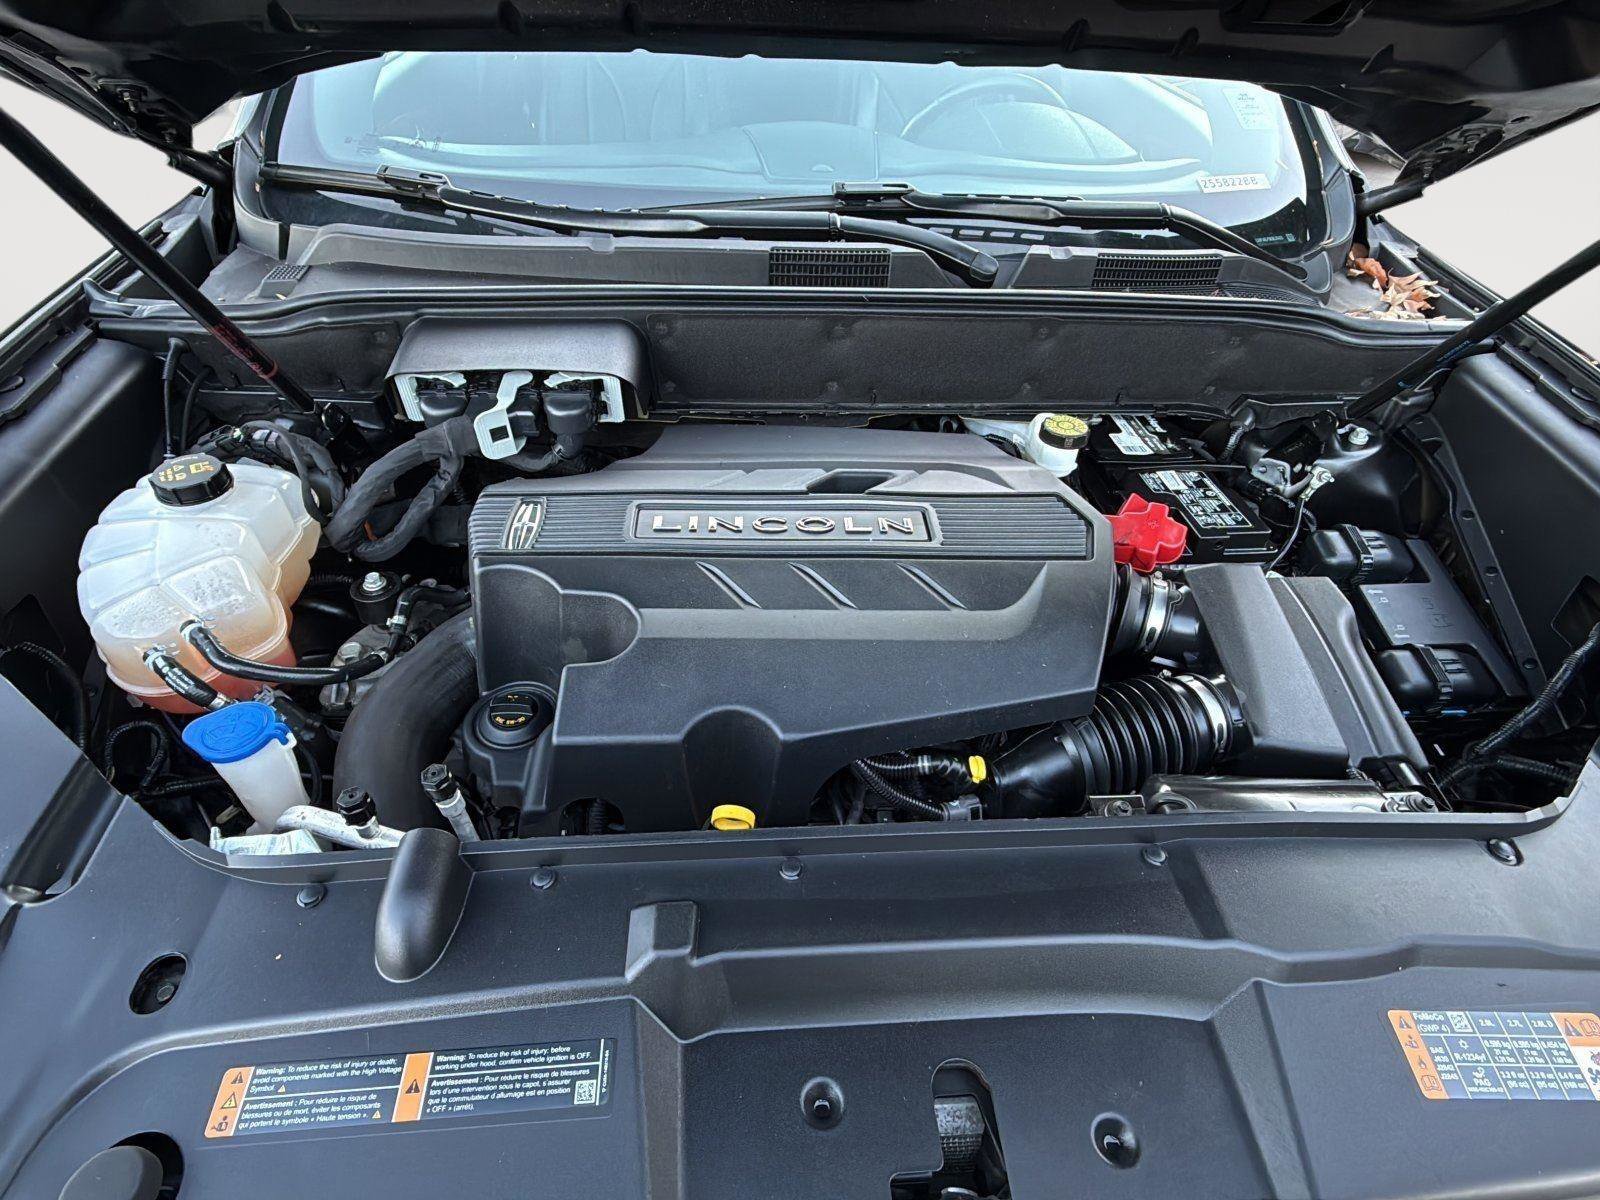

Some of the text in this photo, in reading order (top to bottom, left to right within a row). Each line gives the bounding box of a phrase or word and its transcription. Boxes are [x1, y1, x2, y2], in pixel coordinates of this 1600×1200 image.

[652, 514, 914, 534] LINCOLN
[1417, 1023, 1440, 1032] (GWP
[437, 1054, 466, 1062] Warning:
[546, 1054, 568, 1063] ignition
[271, 1074, 309, 1082] components
[362, 1068, 377, 1076] High
[431, 1077, 479, 1087] Avertissement
[1473, 1078, 1491, 1086] PAG
[461, 1084, 497, 1093] intervention
[449, 1094, 490, 1102] commutateur
[546, 1087, 570, 1096] position
[244, 1100, 293, 1110] Avertissement
[342, 1102, 381, 1111] composants
[432, 1105, 446, 1113] OFF
[249, 1120, 272, 1129] portent
[281, 1117, 309, 1126] symbole
